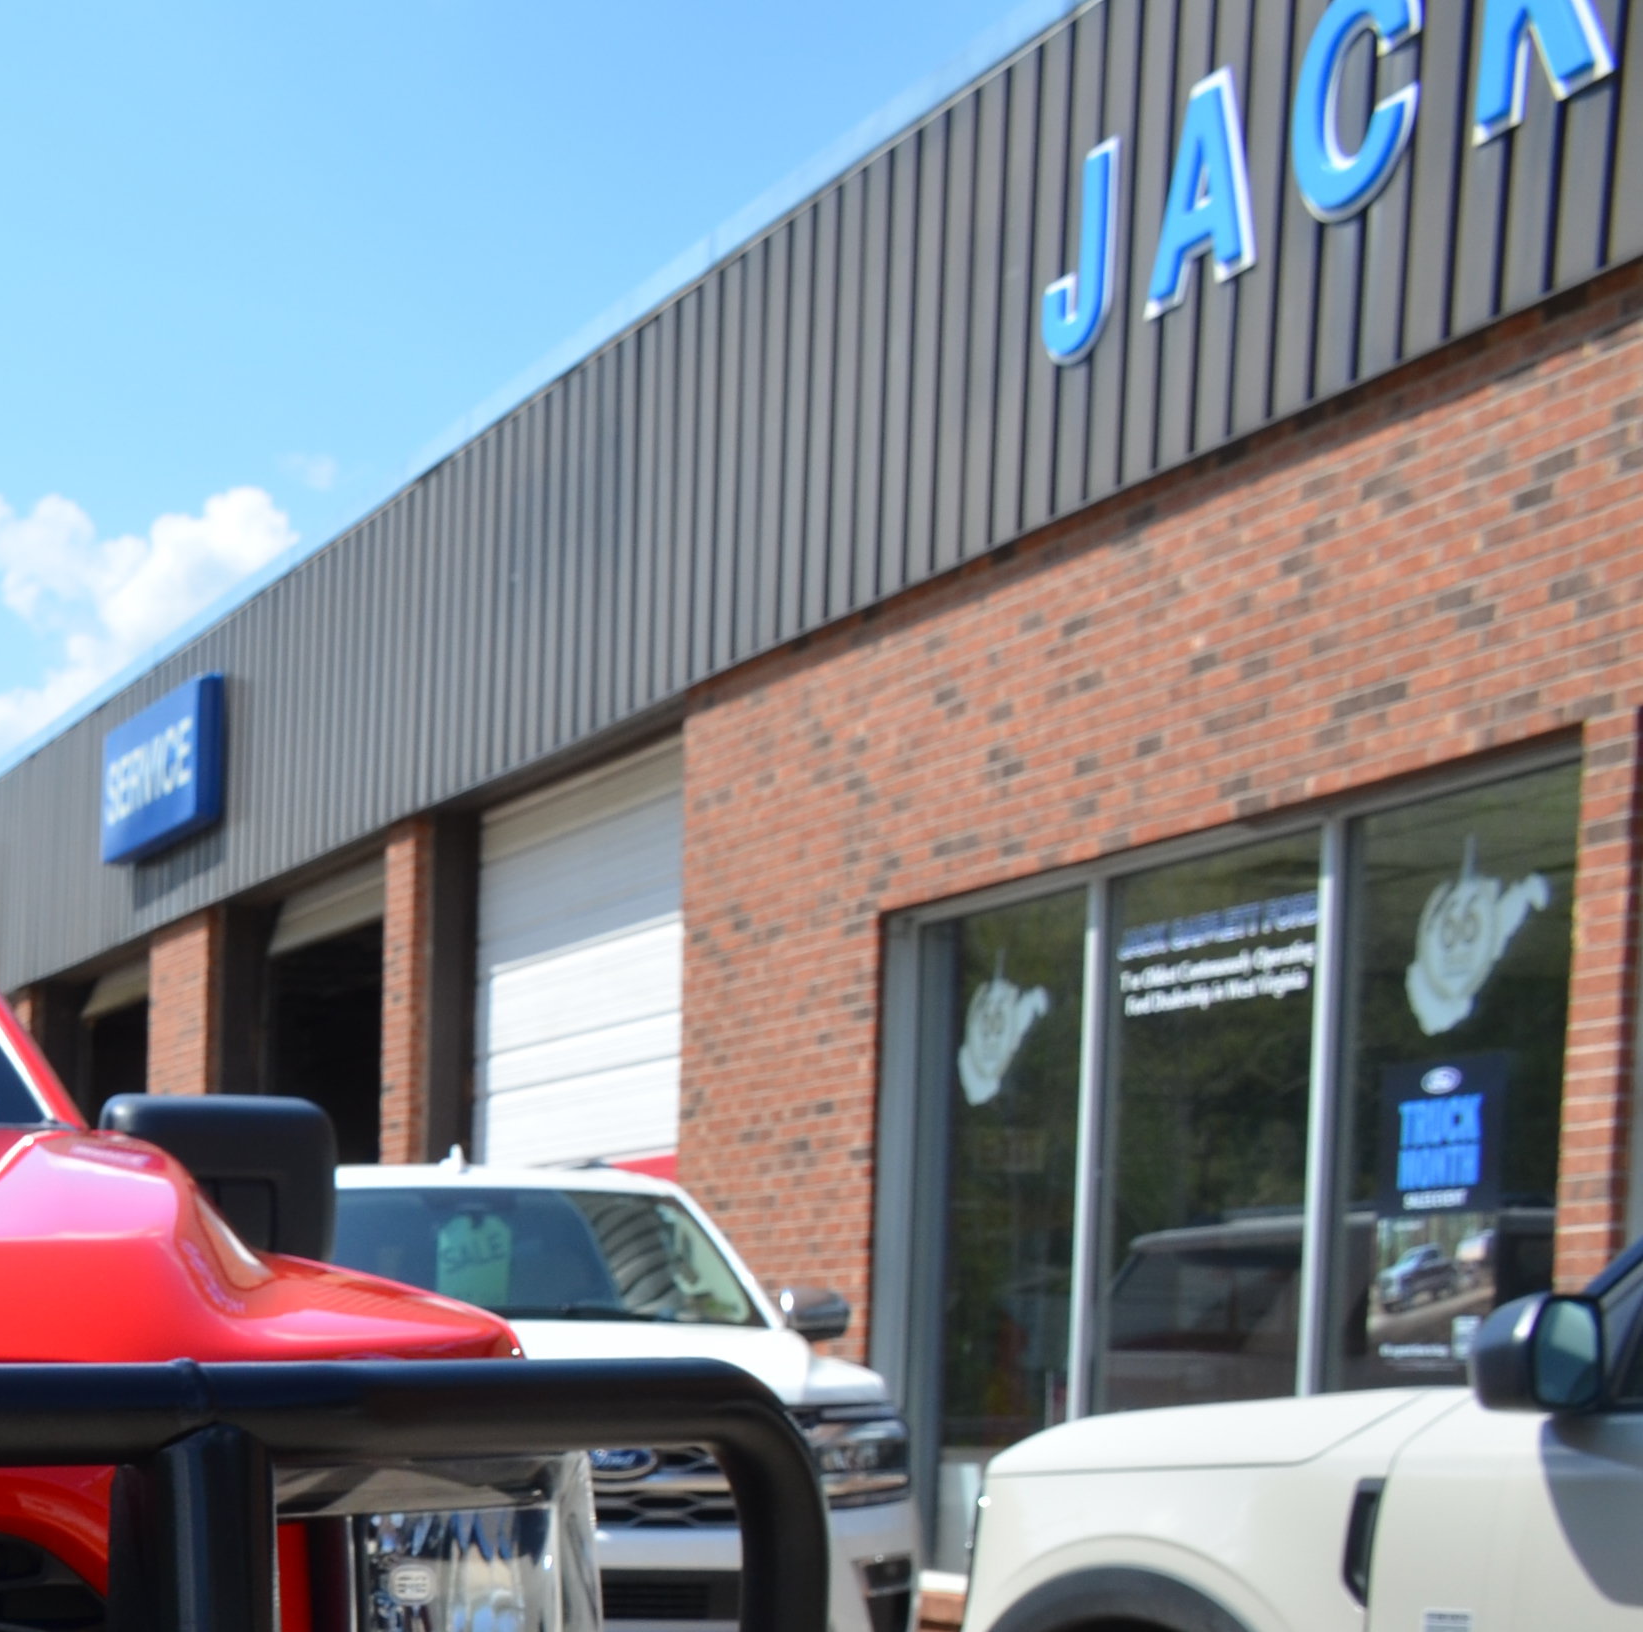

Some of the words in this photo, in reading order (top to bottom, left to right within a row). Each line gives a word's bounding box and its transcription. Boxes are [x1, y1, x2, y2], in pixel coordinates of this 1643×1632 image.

[106, 715, 193, 826] SERVICE
[1398, 1093, 1484, 1148] TRUCK
[1397, 1143, 1481, 1190] MONTH
